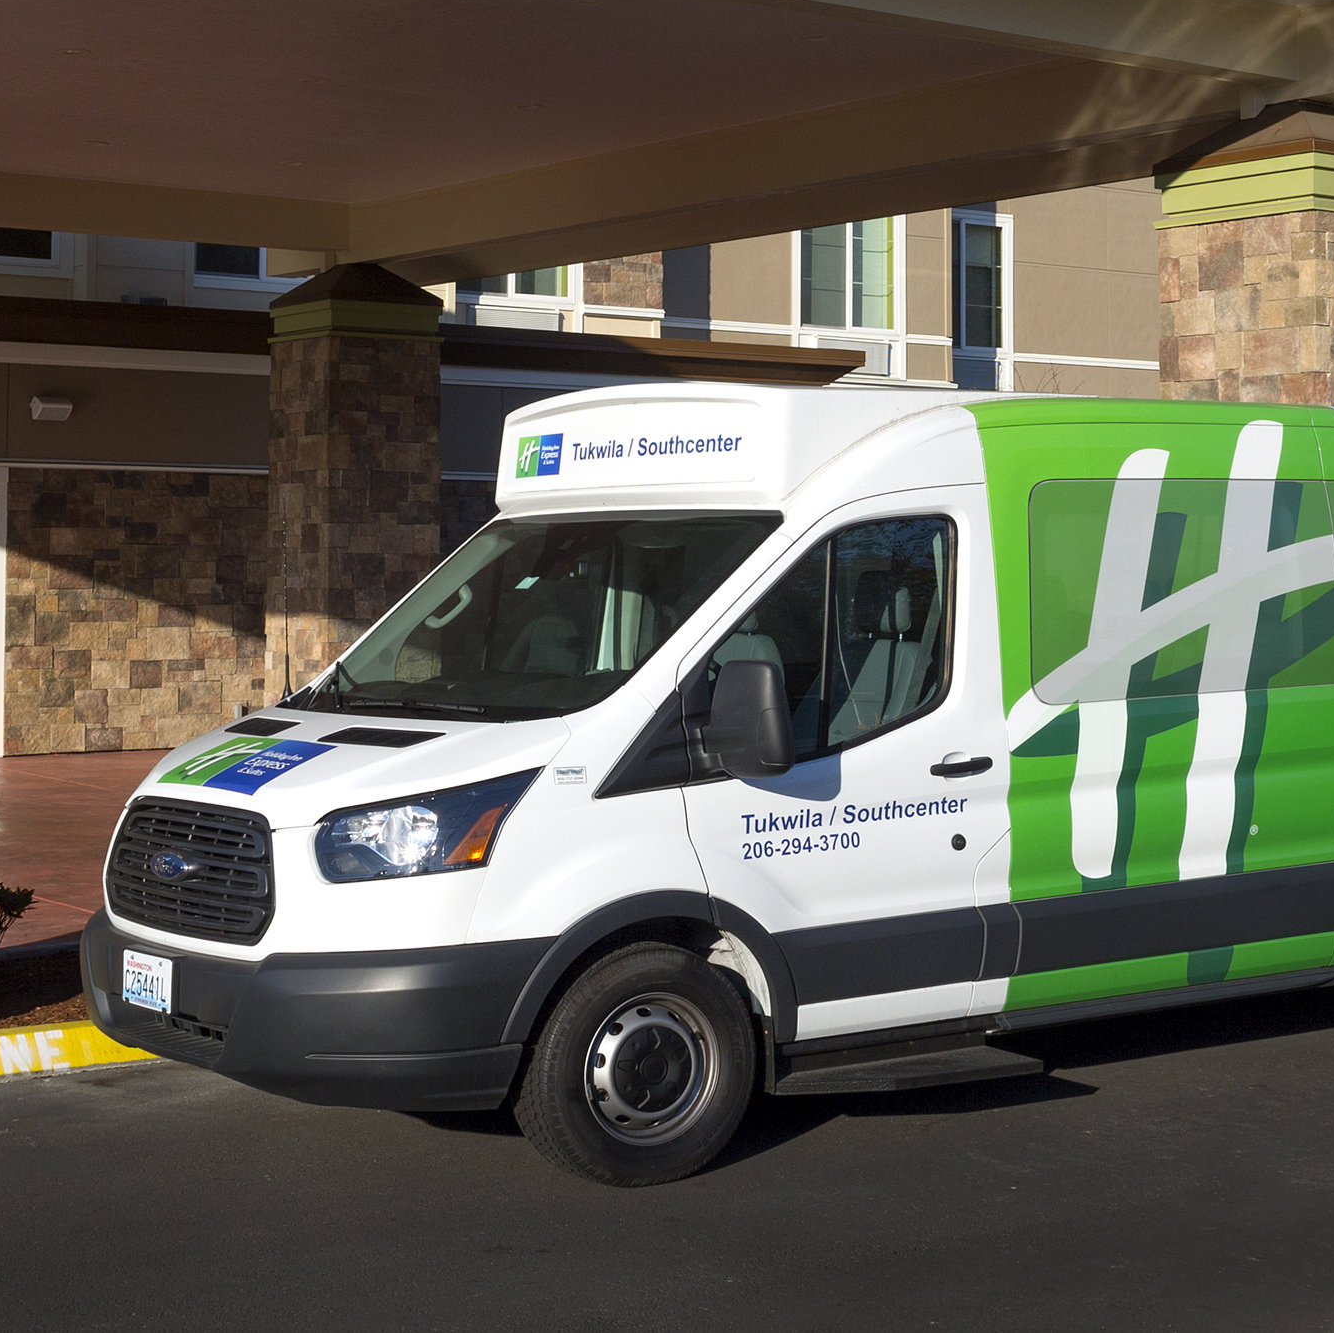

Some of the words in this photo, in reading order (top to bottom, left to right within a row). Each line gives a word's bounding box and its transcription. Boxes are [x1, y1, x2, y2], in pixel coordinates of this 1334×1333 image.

[572, 440, 624, 461] Tukwila
[637, 433, 742, 457] Southcenter
[244, 756, 290, 770] Express
[741, 809, 823, 835] Tukwila
[842, 797, 968, 824] Southcenter
[742, 831, 861, 860] 206-294-3700
[125, 969, 167, 1003] C25441L
